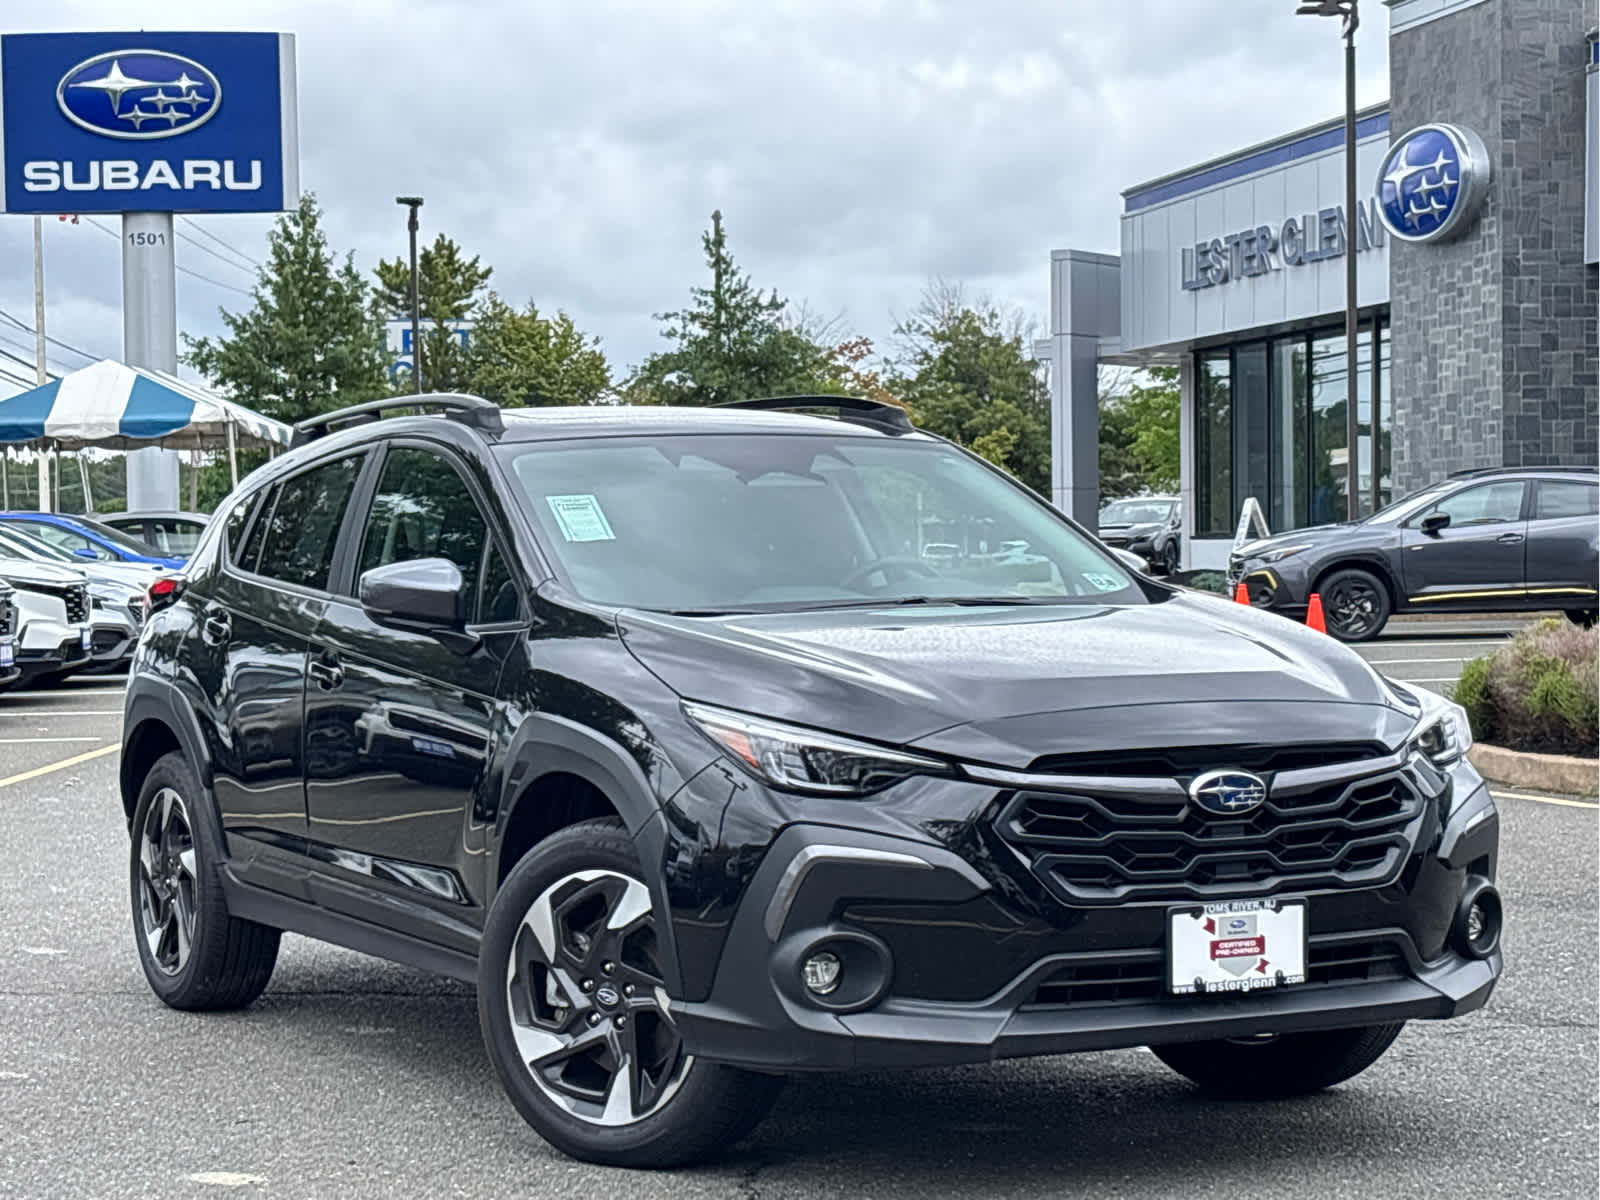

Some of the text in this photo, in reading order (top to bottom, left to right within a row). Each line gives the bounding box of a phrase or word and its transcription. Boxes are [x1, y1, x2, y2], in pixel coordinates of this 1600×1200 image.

[23, 159, 262, 192] SUBARU
[127, 231, 166, 246] 1501
[1181, 225, 1280, 291] LESTER
[1203, 902, 1231, 914] TOMS
[1264, 899, 1277, 909] NJ
